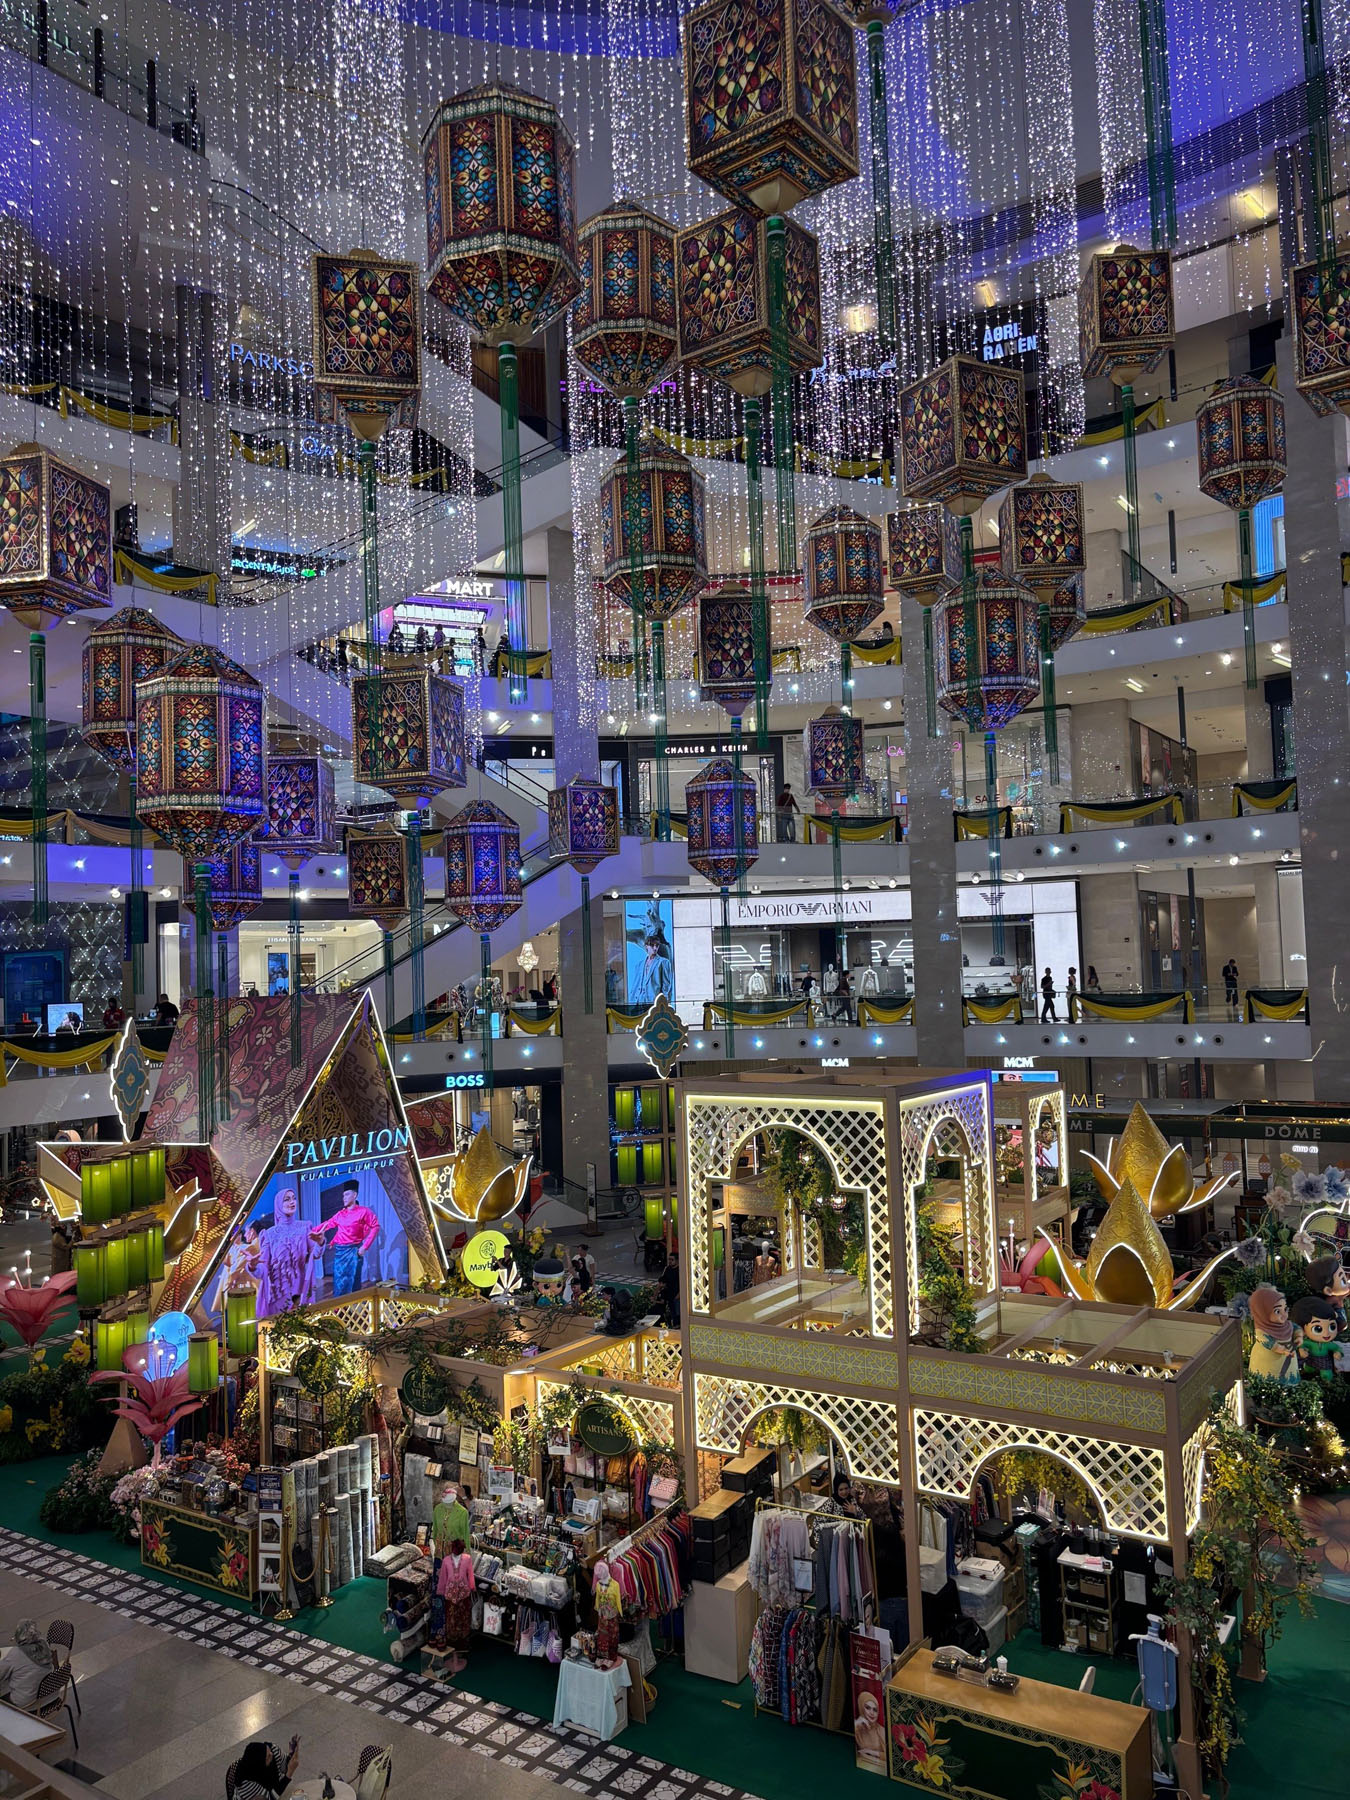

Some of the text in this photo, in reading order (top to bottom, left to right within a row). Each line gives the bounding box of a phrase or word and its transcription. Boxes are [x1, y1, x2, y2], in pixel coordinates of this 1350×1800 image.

[983, 335, 1037, 361] RAMEN
[230, 343, 315, 379] PARKSO
[446, 580, 494, 596] MART
[664, 744, 748, 754] CHARLES & KEITH
[737, 900, 873, 918] EMPORIO ARMANI
[821, 1057, 849, 1068] MCM
[1004, 1056, 1034, 1068] MCM
[446, 1074, 485, 1088] BOSS
[1070, 1093, 1105, 1109] ME
[1069, 1119, 1093, 1131] ME
[286, 1125, 411, 1168] PAVILION
[300, 1158, 395, 1182] KUALA LUMPUR
[469, 1261, 493, 1272] Mayb
[586, 1424, 624, 1438] ARTISANS
